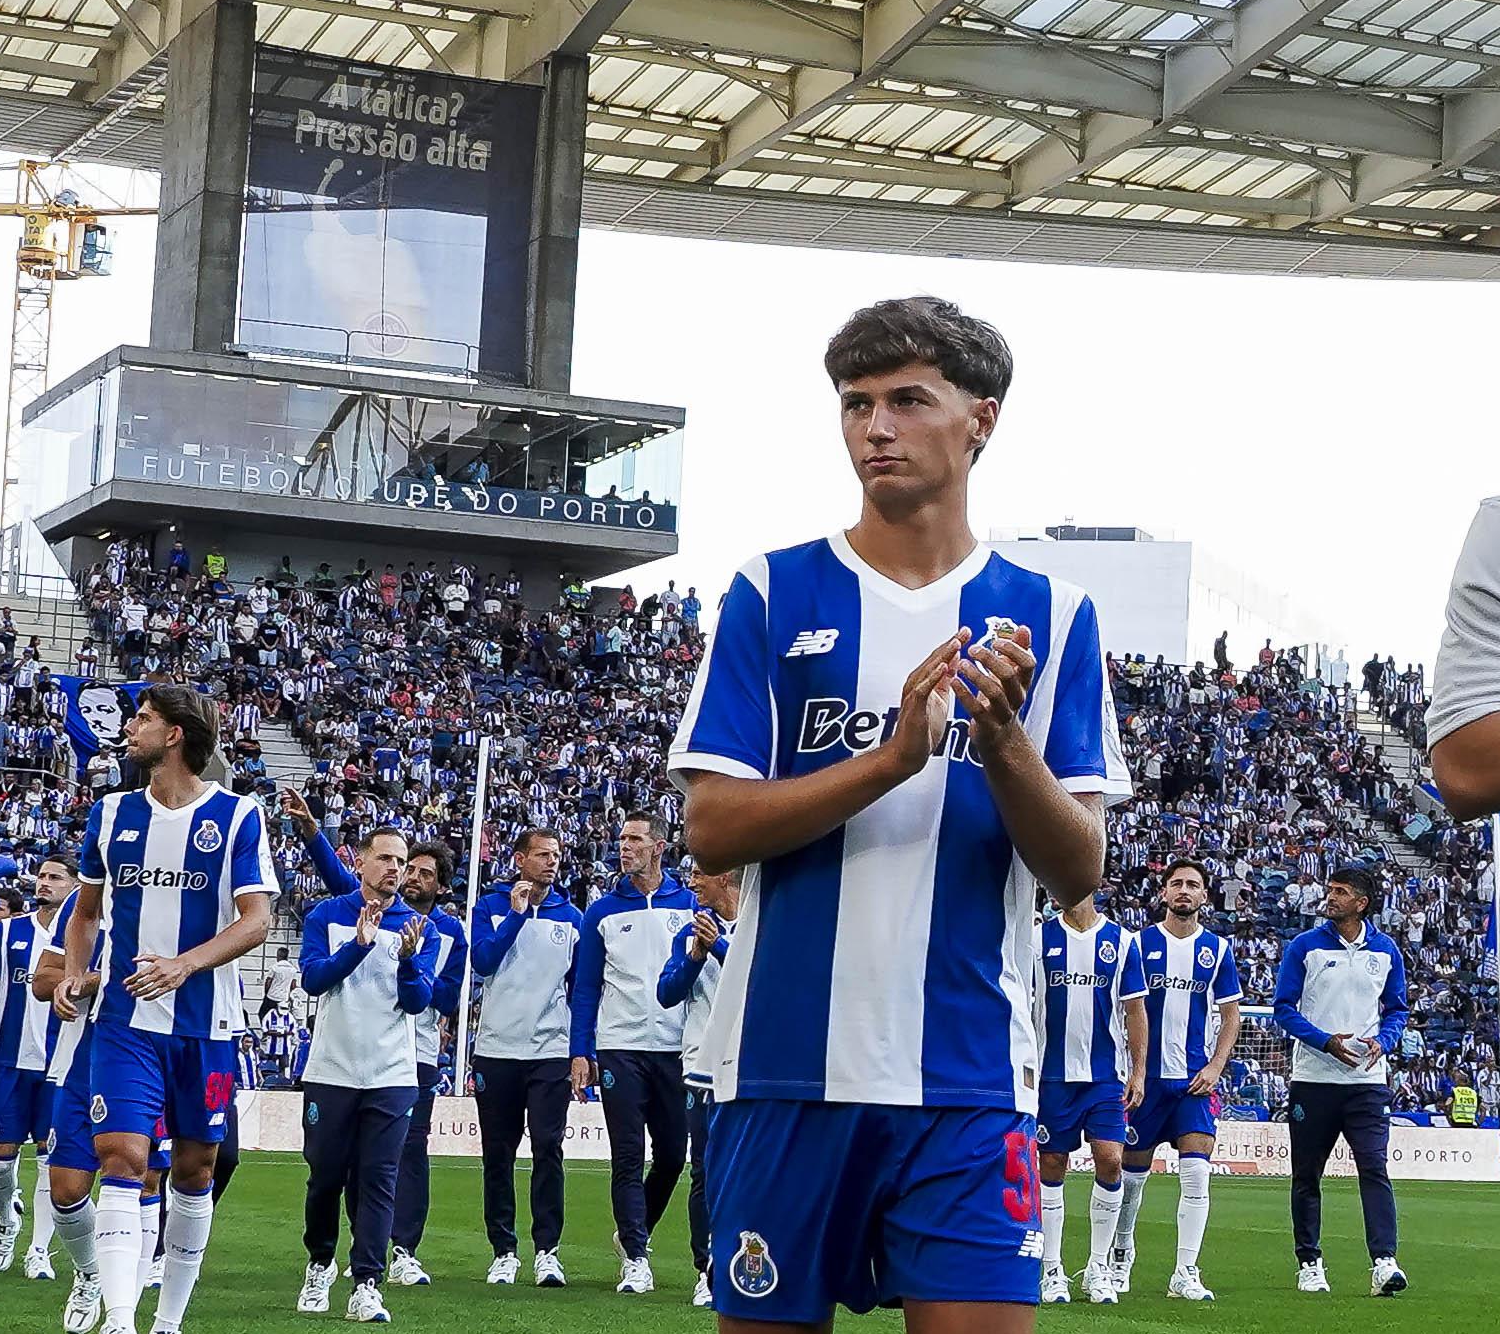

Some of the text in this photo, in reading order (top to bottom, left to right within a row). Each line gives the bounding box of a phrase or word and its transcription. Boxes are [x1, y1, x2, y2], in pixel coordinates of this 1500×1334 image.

[361, 78, 466, 128] tática?
[295, 109, 492, 172] Pressão alta
[141, 454, 657, 528] FUTEBOL CLUBE DO PORTO
[116, 863, 208, 890] Betano
[1050, 971, 1109, 988] Betano
[1149, 973, 1208, 993] Betano
[564, 1126, 606, 1141] ORT
[1217, 1143, 1289, 1159] FUTEBO
[1414, 1149, 1473, 1164] PORTO
